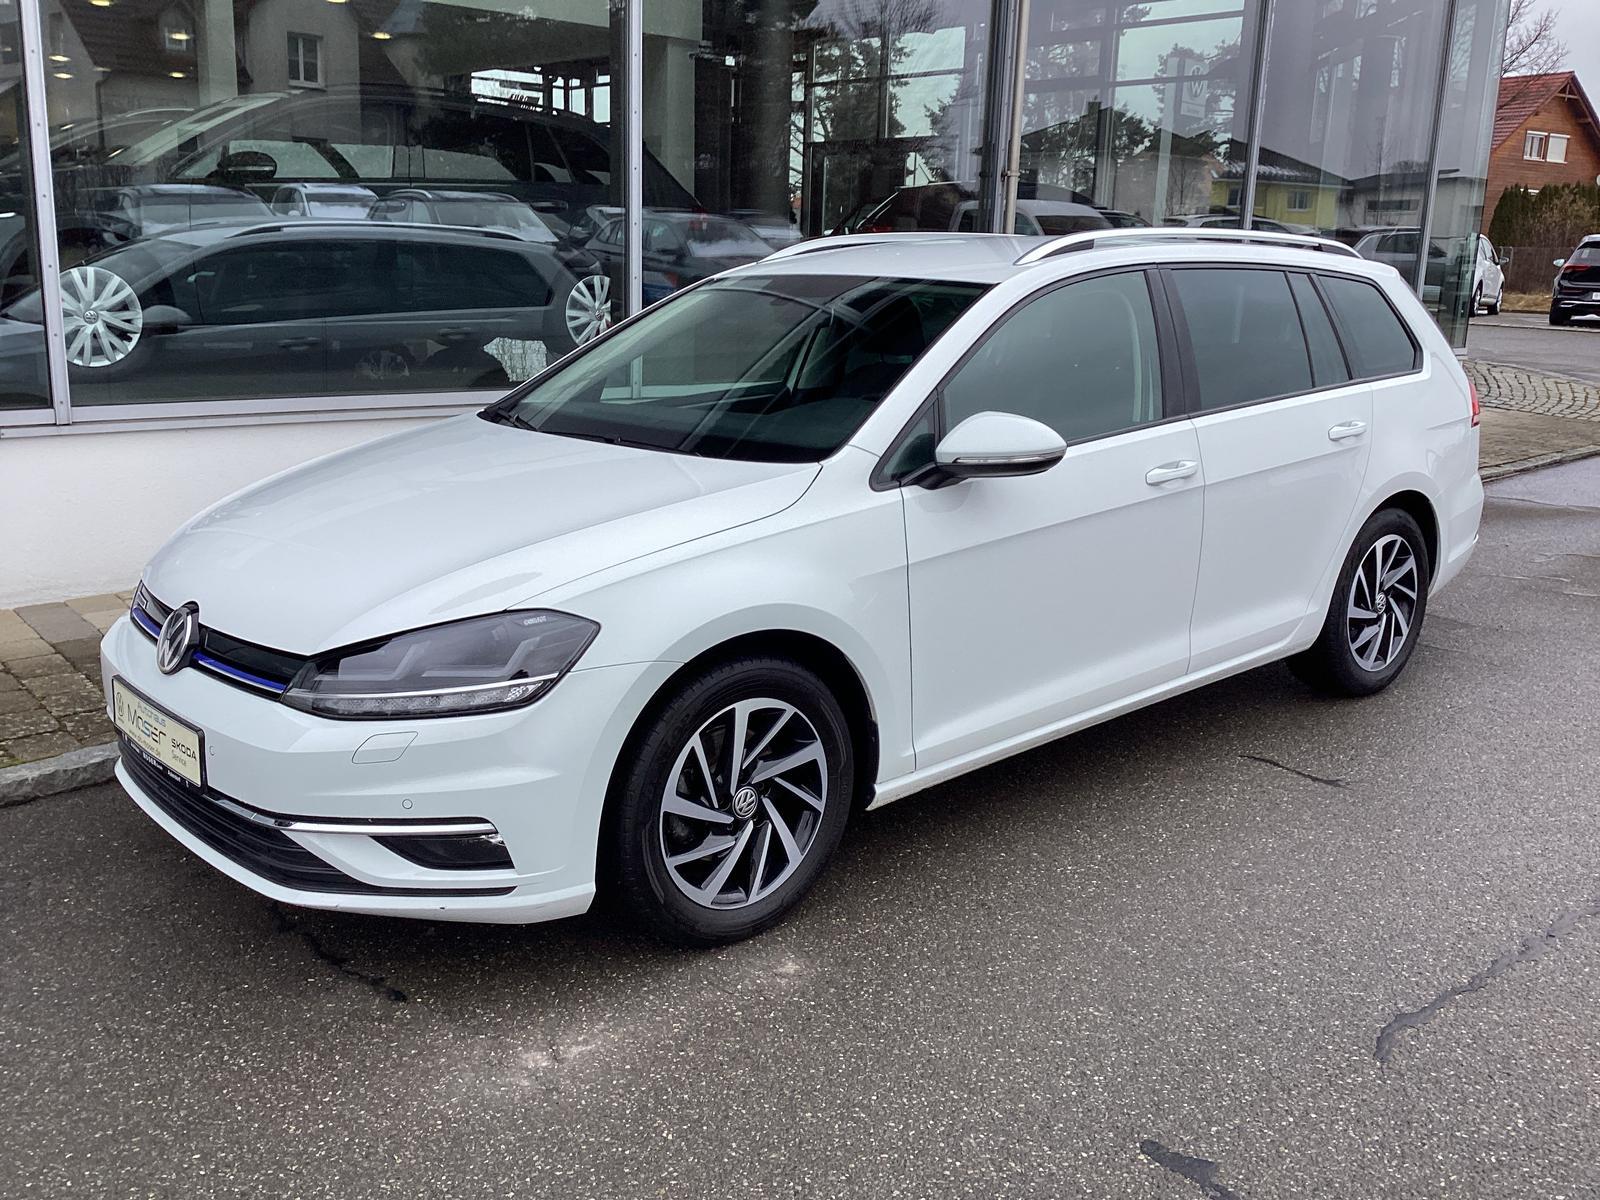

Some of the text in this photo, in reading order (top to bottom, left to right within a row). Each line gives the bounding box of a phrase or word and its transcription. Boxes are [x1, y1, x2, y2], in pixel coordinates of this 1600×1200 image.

[157, 606, 192, 675] VW
[137, 701, 167, 728] Autohaus
[171, 749, 187, 768] Service
[732, 785, 759, 819] VW
